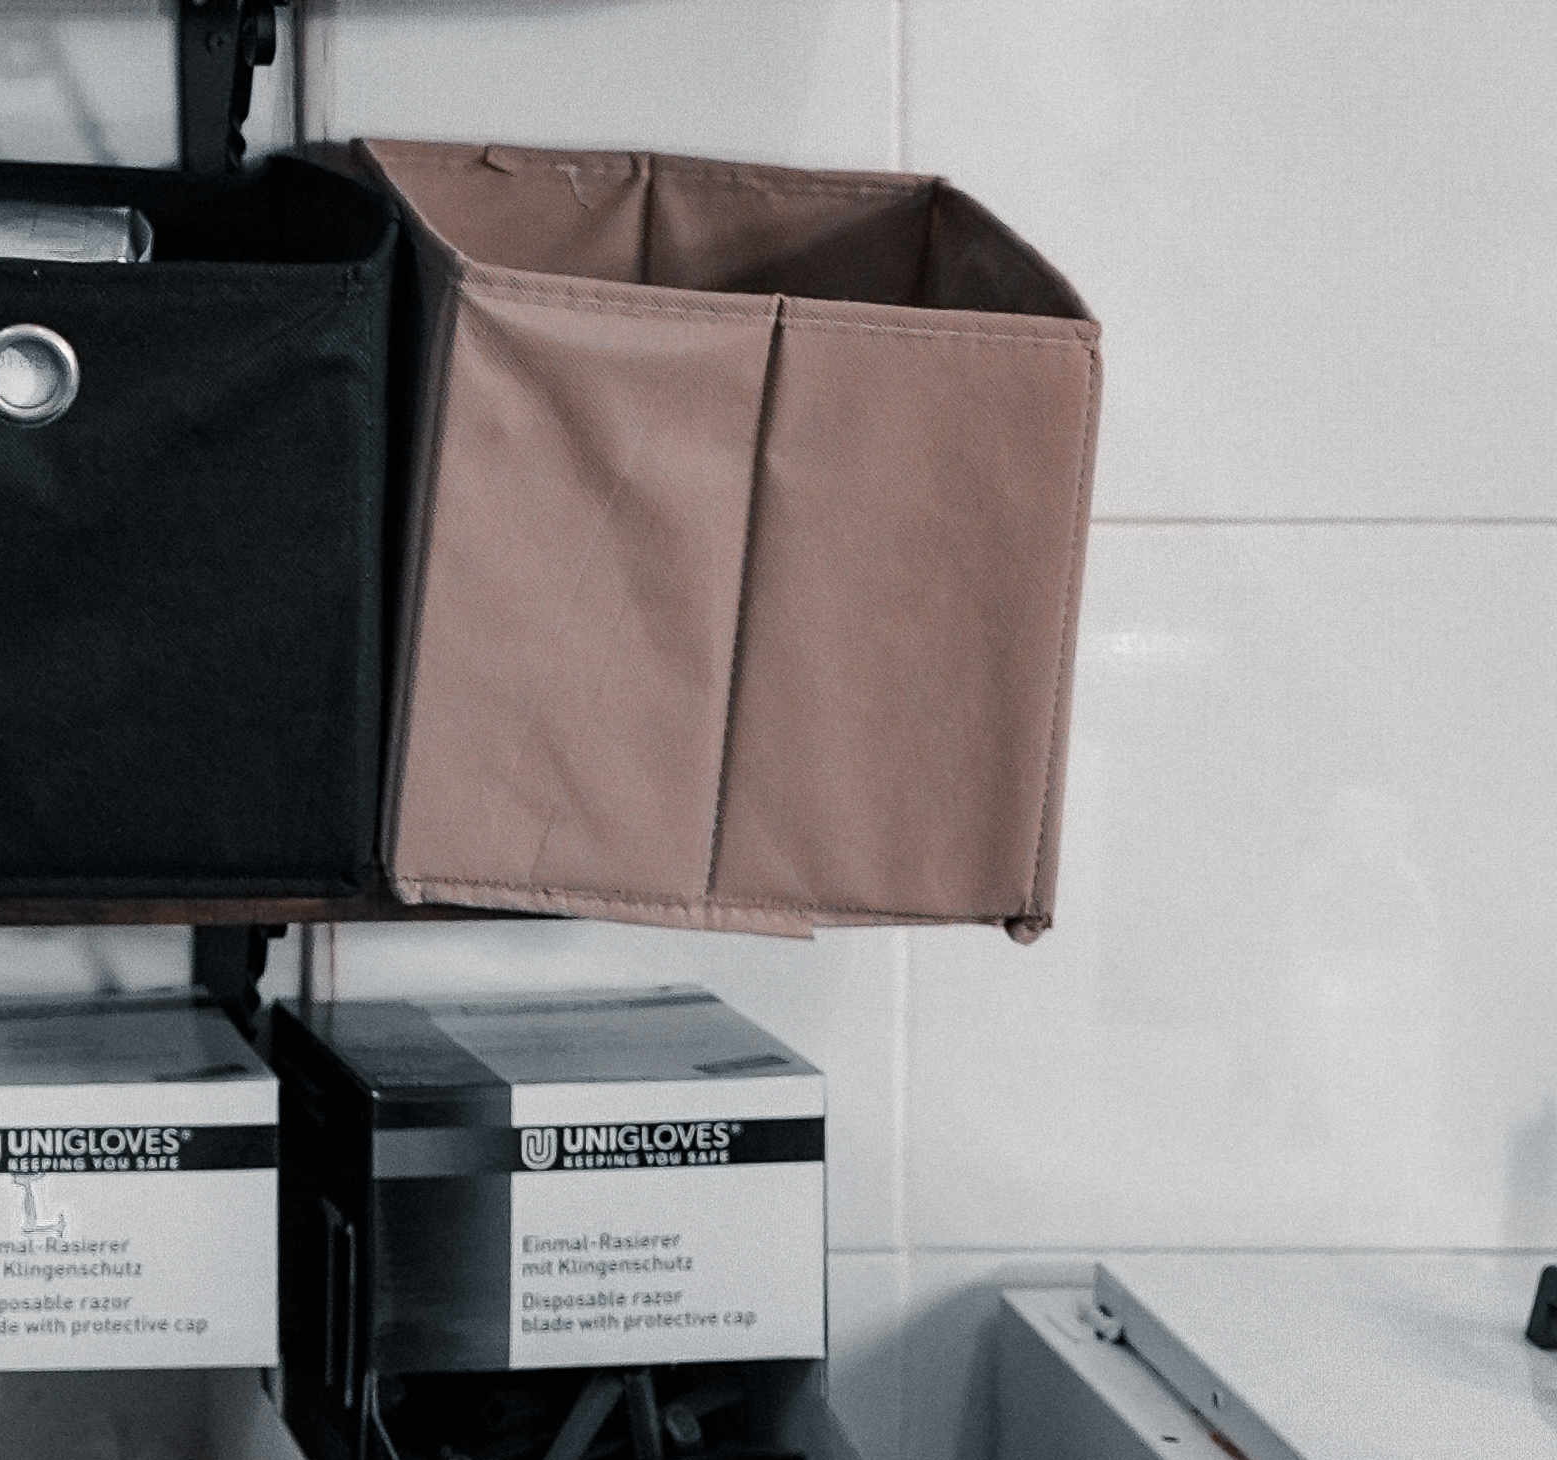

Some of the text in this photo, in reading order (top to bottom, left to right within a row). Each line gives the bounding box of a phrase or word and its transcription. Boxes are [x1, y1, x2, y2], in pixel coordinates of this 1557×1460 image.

[8, 1129, 180, 1156] UNIGLOVES
[563, 1123, 730, 1153] UNIGLOVES
[8, 1156, 179, 1171] KEEPING YOU SAFE
[563, 1150, 730, 1168] KEEPING YOU SAFE
[26, 1319, 65, 1333] with
[72, 1318, 168, 1336] protective
[175, 1318, 208, 1335] cap
